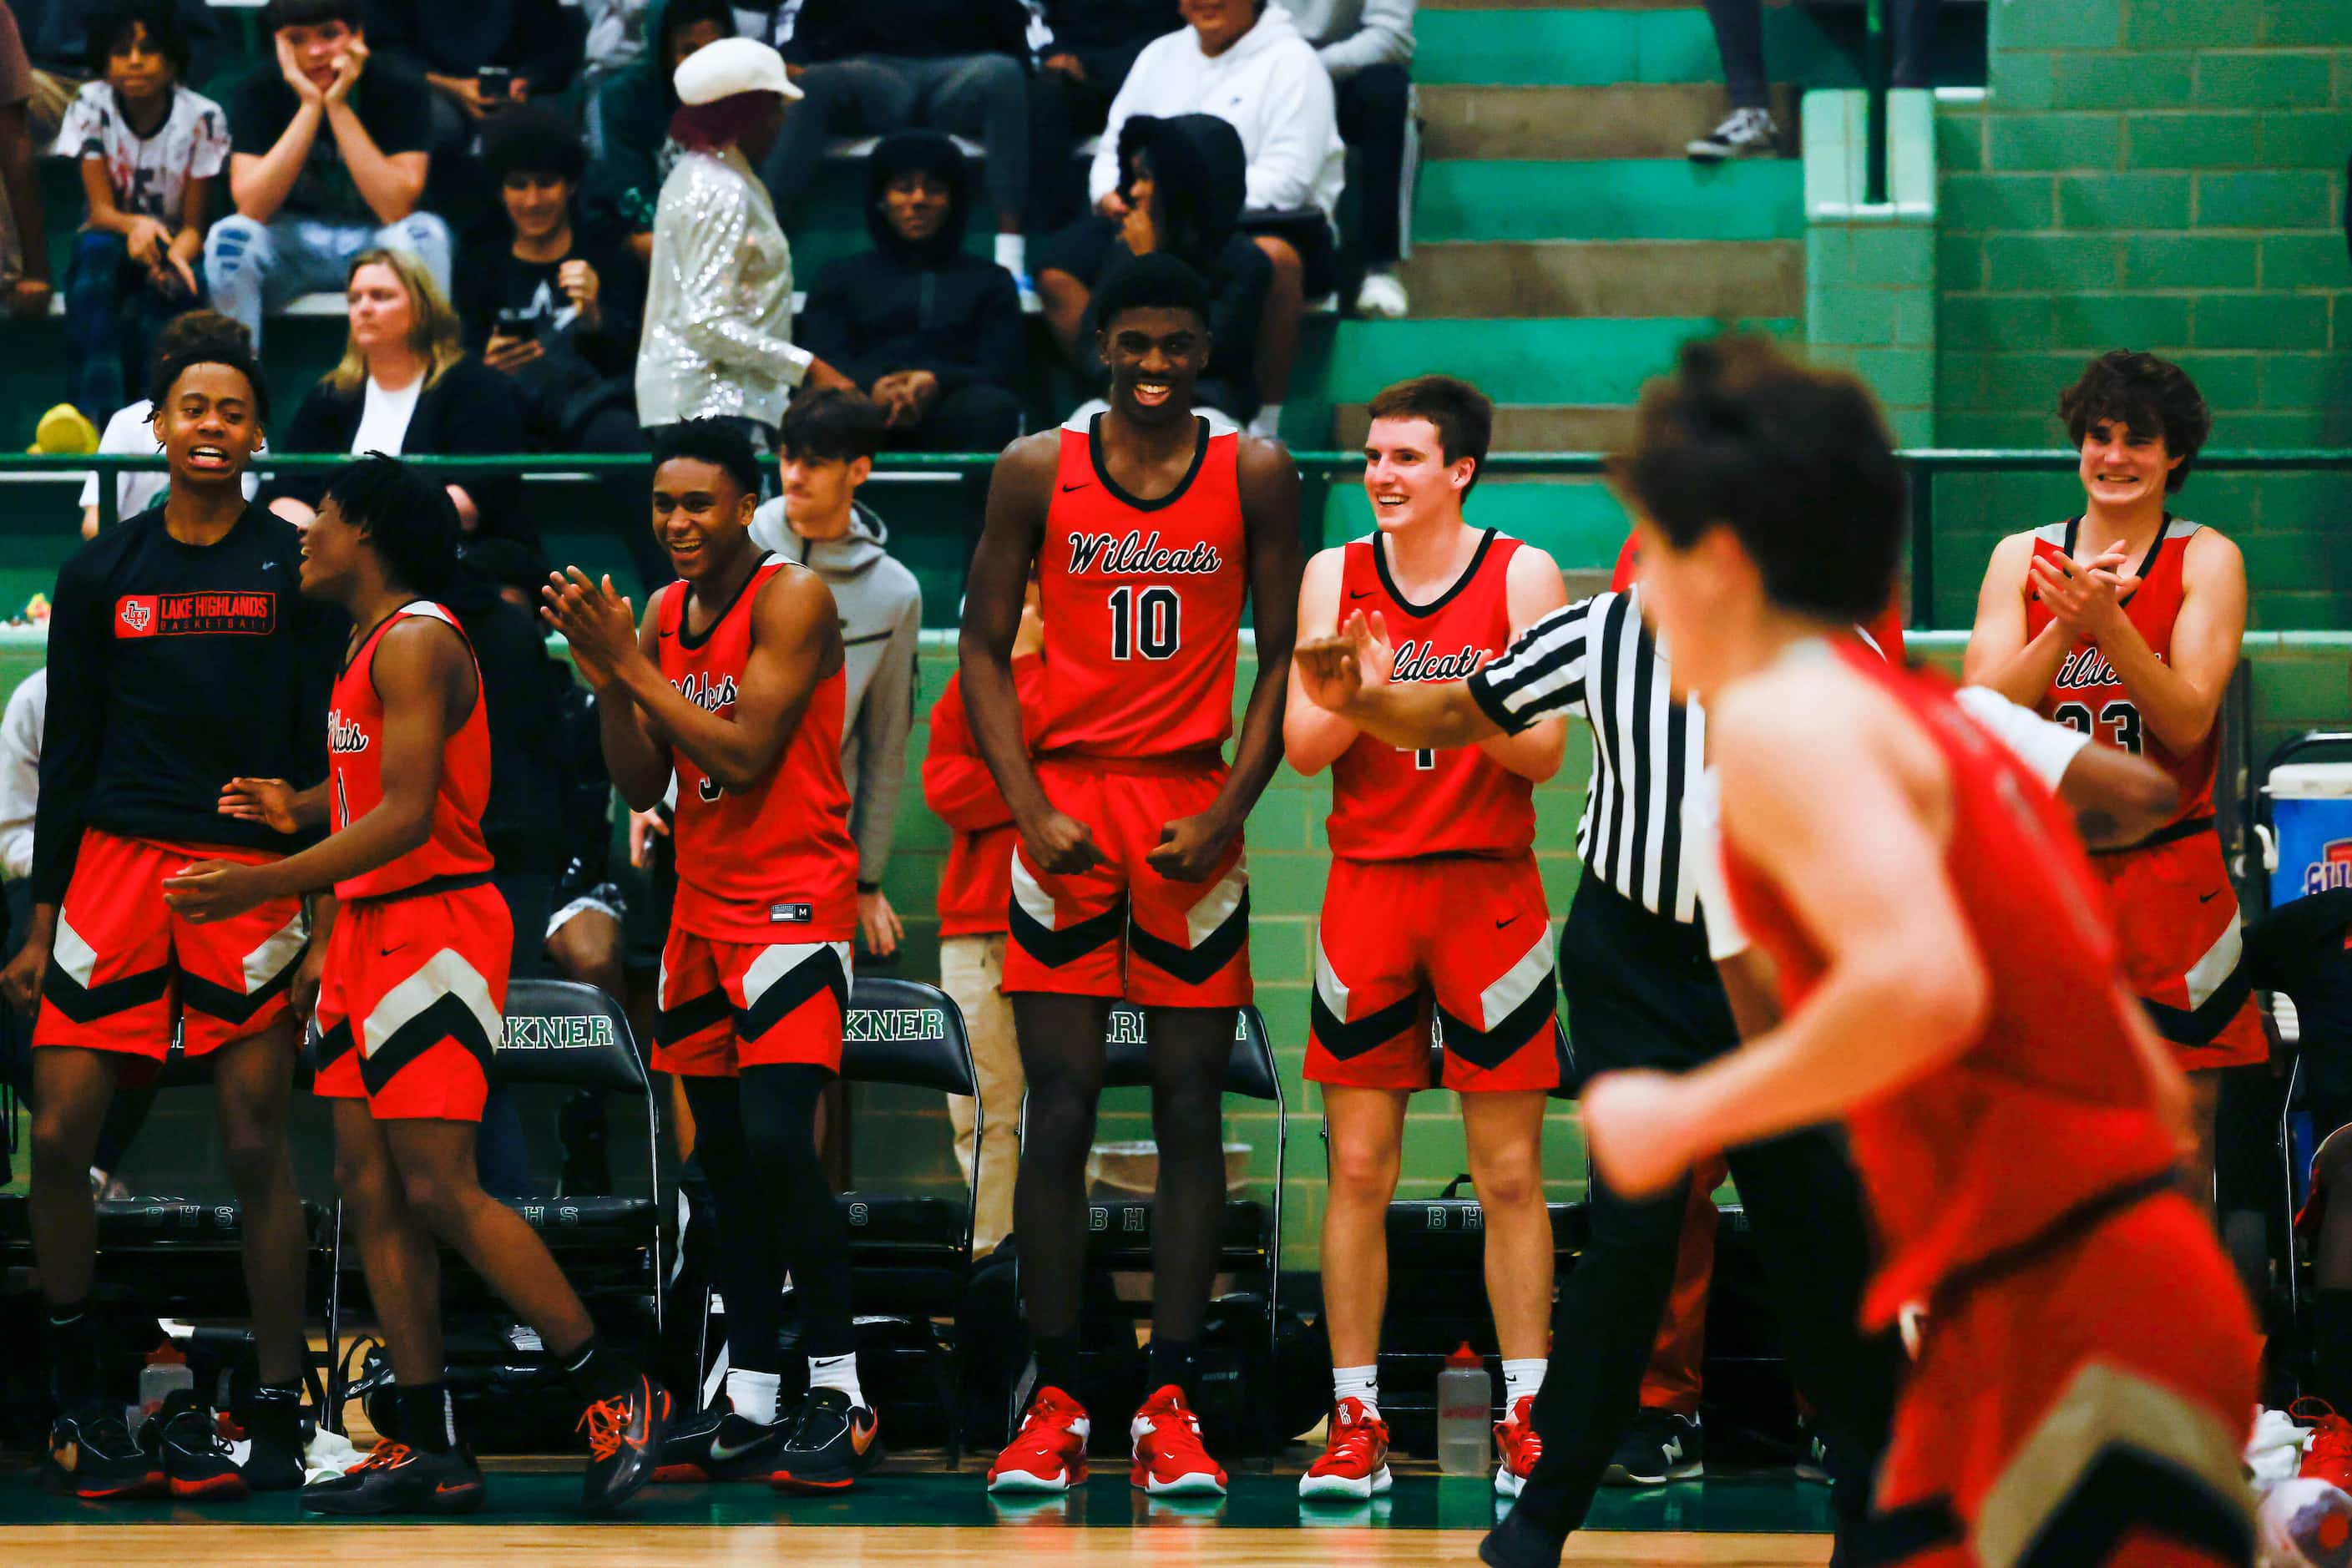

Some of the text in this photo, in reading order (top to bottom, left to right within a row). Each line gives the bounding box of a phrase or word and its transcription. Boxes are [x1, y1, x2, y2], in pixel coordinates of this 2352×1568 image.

[1068, 529, 1222, 574] Wildcats
[159, 618, 267, 631] BASKETBALL
[161, 595, 268, 620] LAKE HIGHLANDS
[1108, 585, 1181, 660] 10
[1389, 640, 1484, 682] ldcat
[799, 908, 807, 917] M
[498, 1014, 615, 1050] KNER
[842, 1009, 944, 1042] KNER
